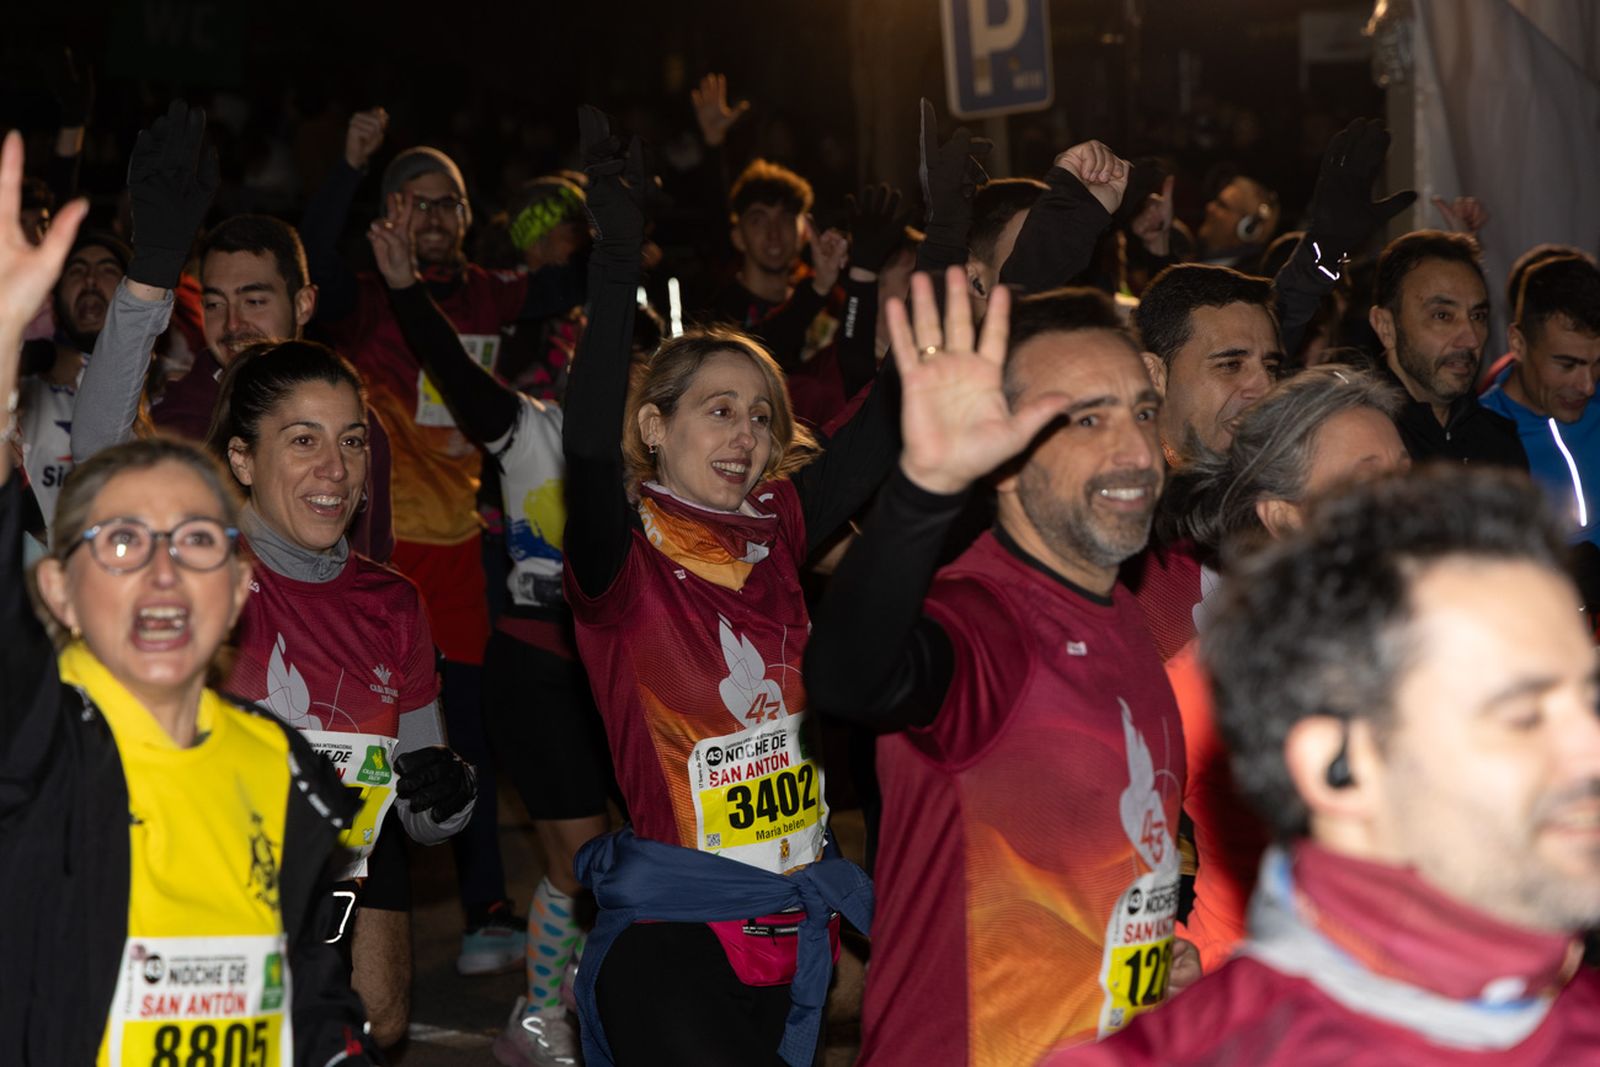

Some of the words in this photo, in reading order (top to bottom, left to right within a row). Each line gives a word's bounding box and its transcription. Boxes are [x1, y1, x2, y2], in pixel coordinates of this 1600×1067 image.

[143, 0, 217, 49] WC
[967, 0, 1029, 97] P
[42, 465, 64, 487] Si
[331, 750, 353, 763] DE
[725, 738, 770, 763] NOCHE
[771, 733, 787, 751] DE
[709, 766, 742, 788] SAN
[745, 751, 790, 780] ANTÓN
[727, 764, 817, 830] 3402
[1124, 921, 1152, 944] SAN
[167, 963, 223, 987] NOCHE
[228, 962, 248, 986] DE
[140, 992, 183, 1018] SAN
[186, 984, 247, 1017] ANTÓN
[151, 1020, 269, 1067] 8805
